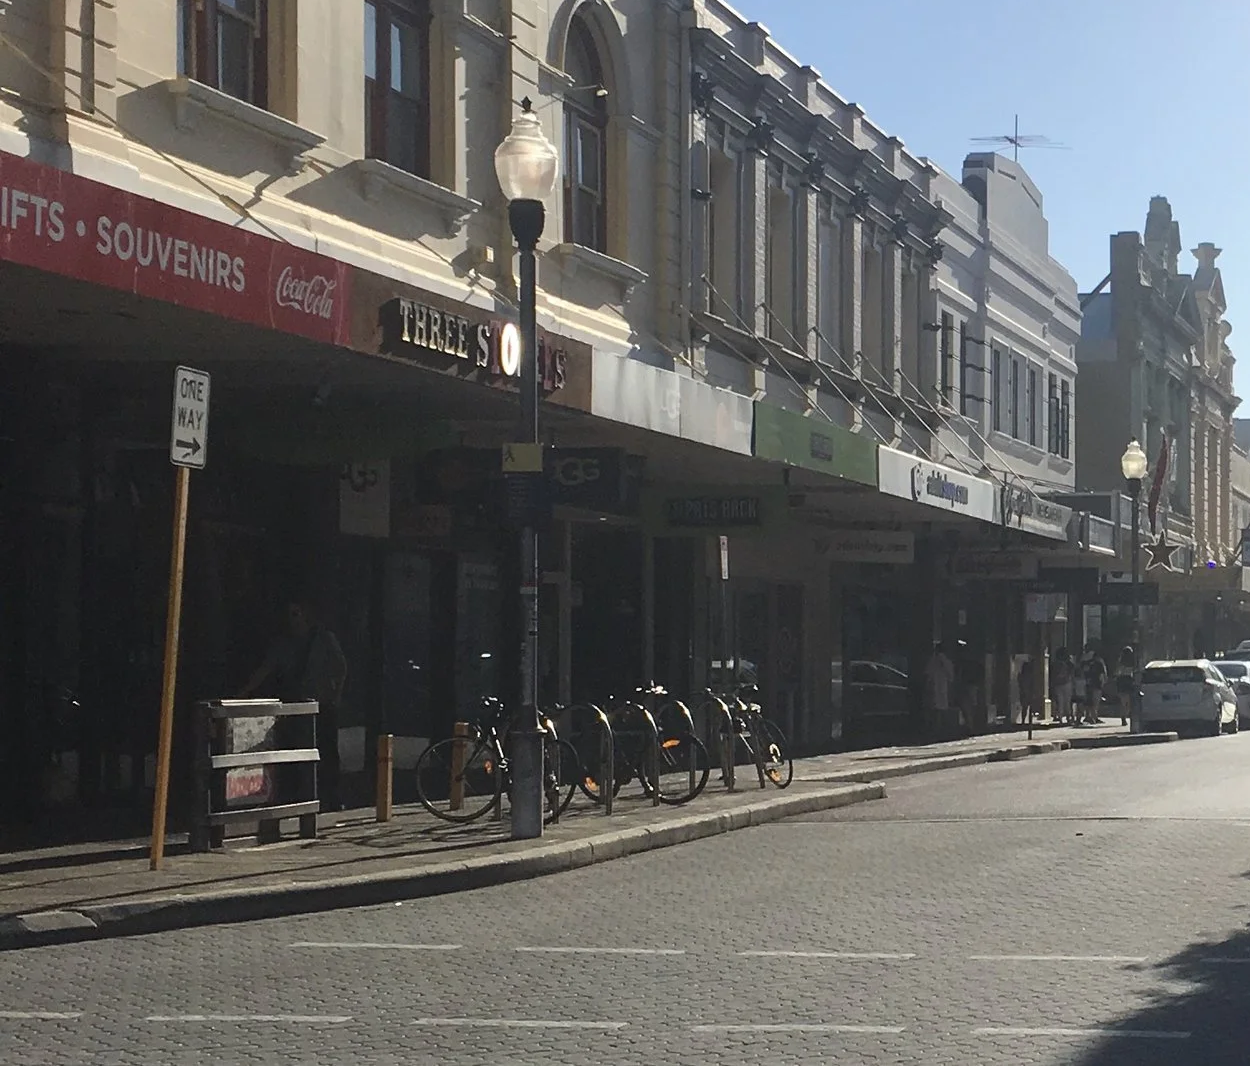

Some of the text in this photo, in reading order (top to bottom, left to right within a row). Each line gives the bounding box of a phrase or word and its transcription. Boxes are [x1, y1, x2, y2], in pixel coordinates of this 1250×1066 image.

[1, 186, 246, 292] IFTS SOUVENIRS
[400, 298, 470, 359] THREE
[181, 377, 204, 402] ONE
[177, 405, 204, 431] WAY
